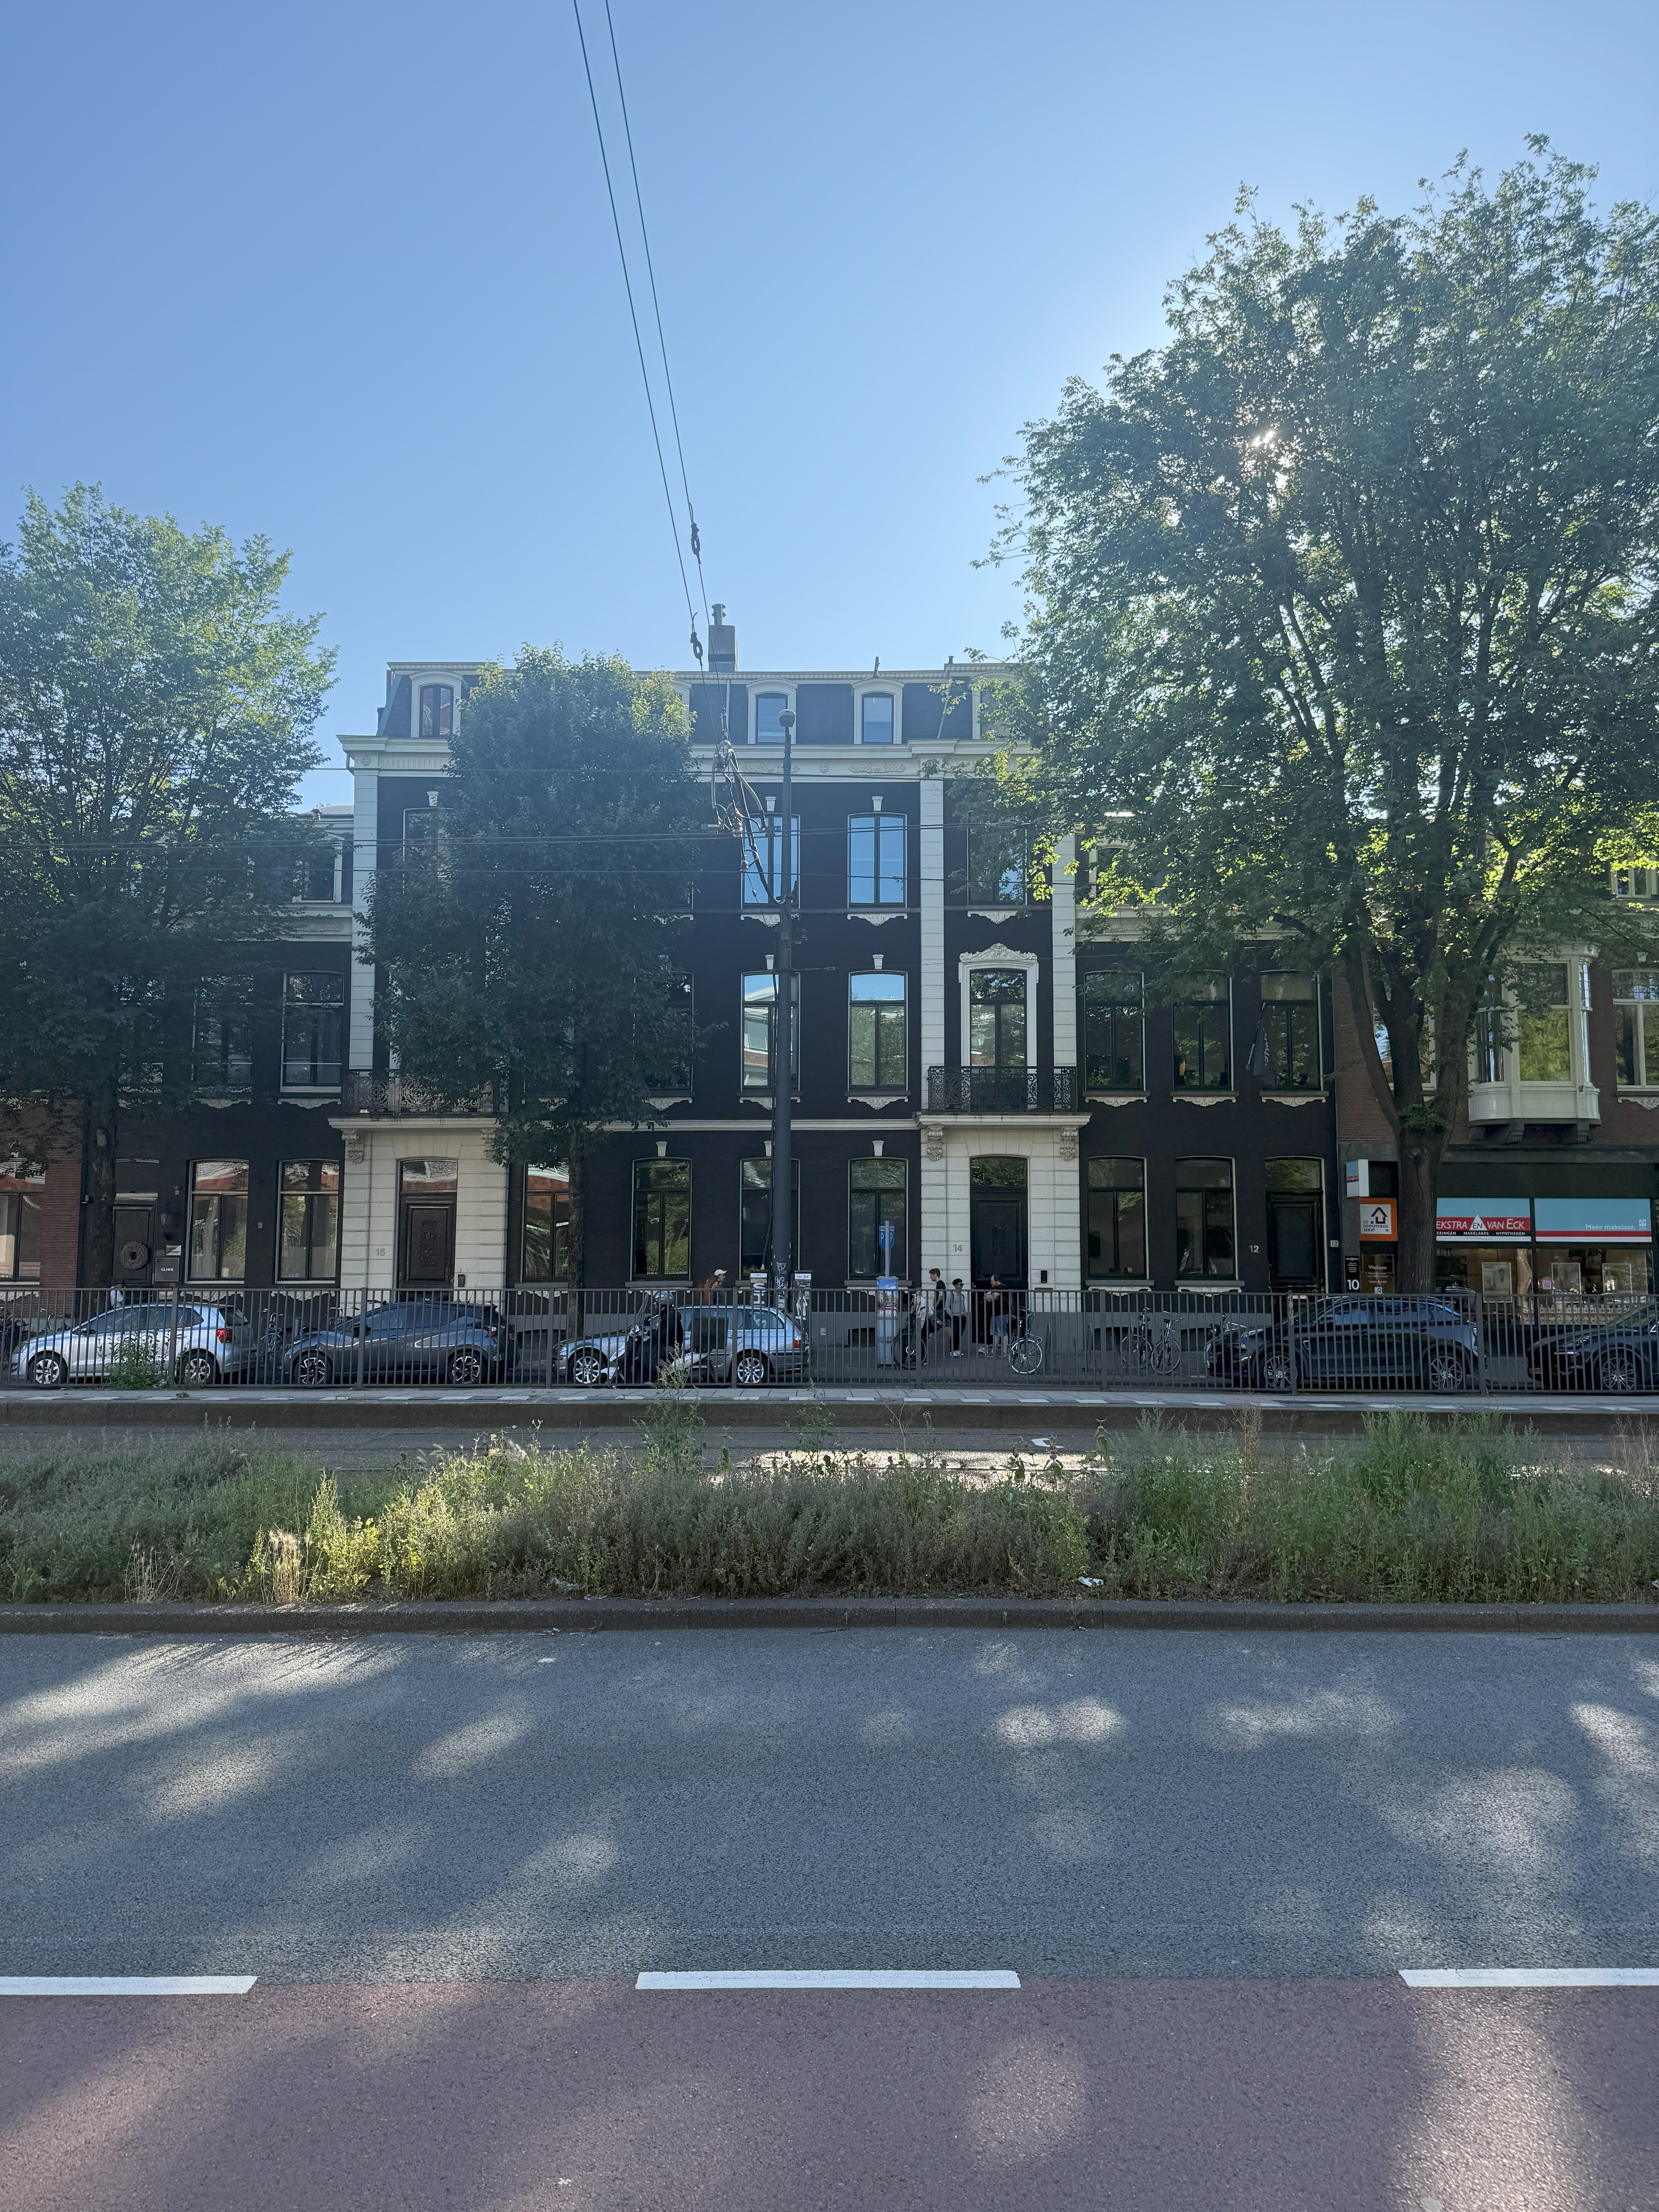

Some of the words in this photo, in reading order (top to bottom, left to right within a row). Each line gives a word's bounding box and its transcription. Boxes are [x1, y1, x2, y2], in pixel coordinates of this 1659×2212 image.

[1487, 1221, 1504, 1229] VAN
[376, 1248, 386, 1256] 16
[1347, 1279, 1360, 1290] 10
